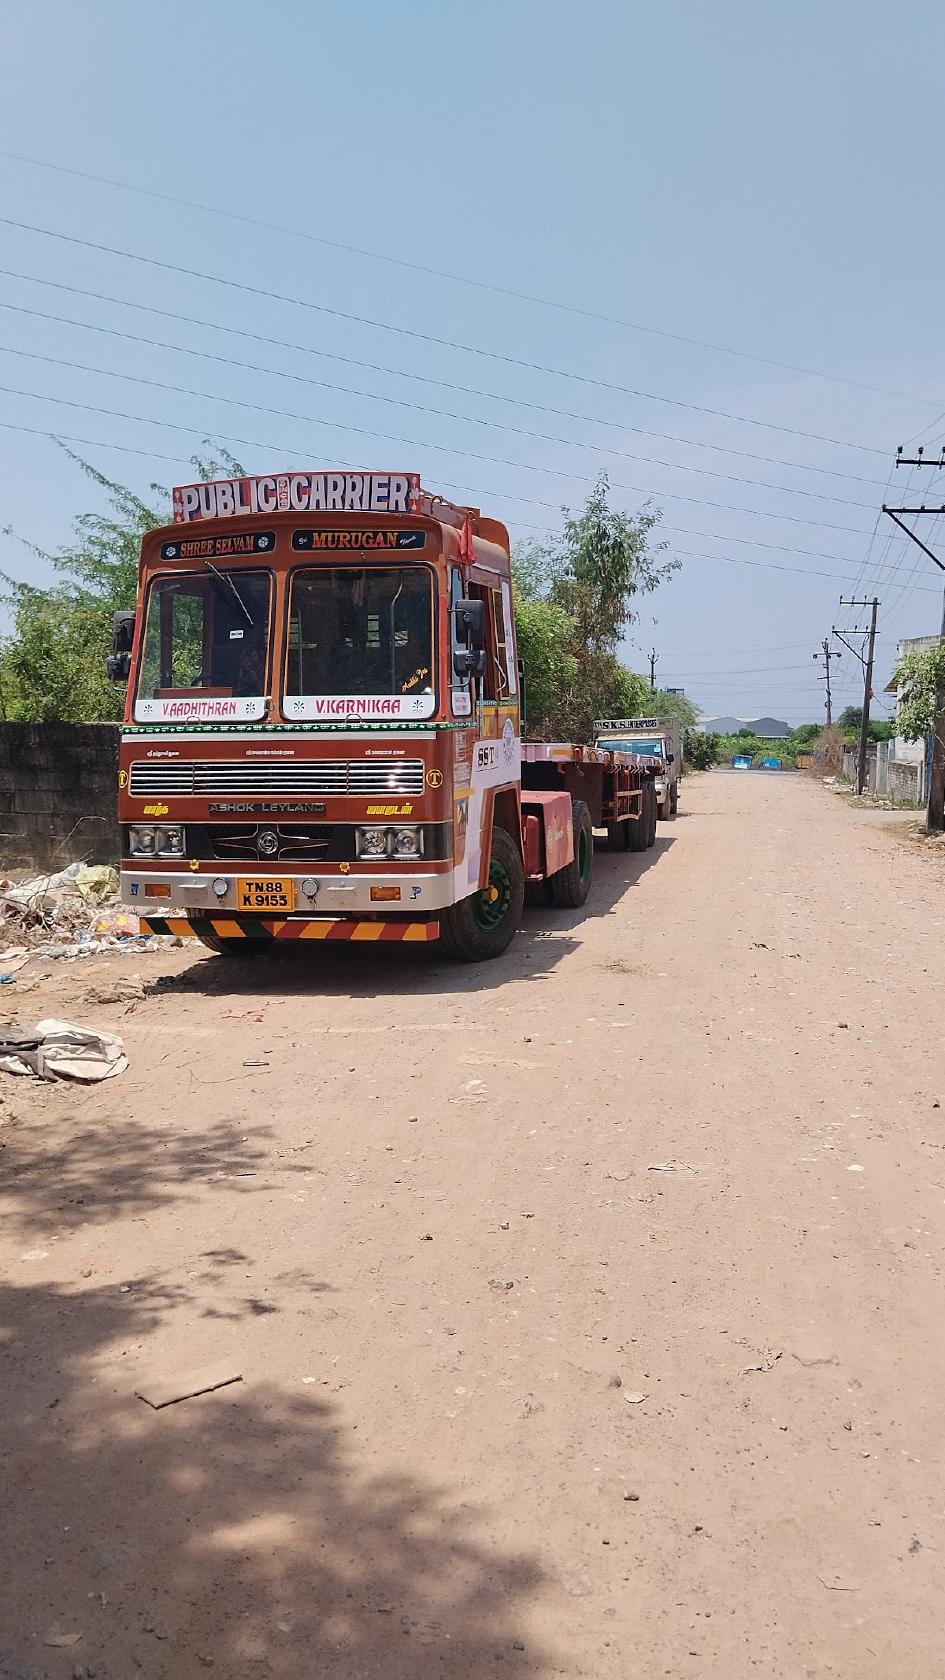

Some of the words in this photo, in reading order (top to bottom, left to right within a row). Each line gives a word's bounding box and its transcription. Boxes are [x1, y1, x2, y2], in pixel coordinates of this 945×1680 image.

[181, 477, 276, 522] PUBLIC
[290, 474, 408, 512] CARRIER
[180, 539, 213, 557] SHREE
[215, 535, 255, 554] SELVAM
[311, 532, 398, 548] MURUGAN
[162, 702, 237, 717] V.AADHITHRAN
[315, 699, 401, 714] V.KARNIKAA
[430, 772, 440, 785] T
[209, 802, 255, 812] ASHOK
[261, 802, 326, 812] LEYLAND
